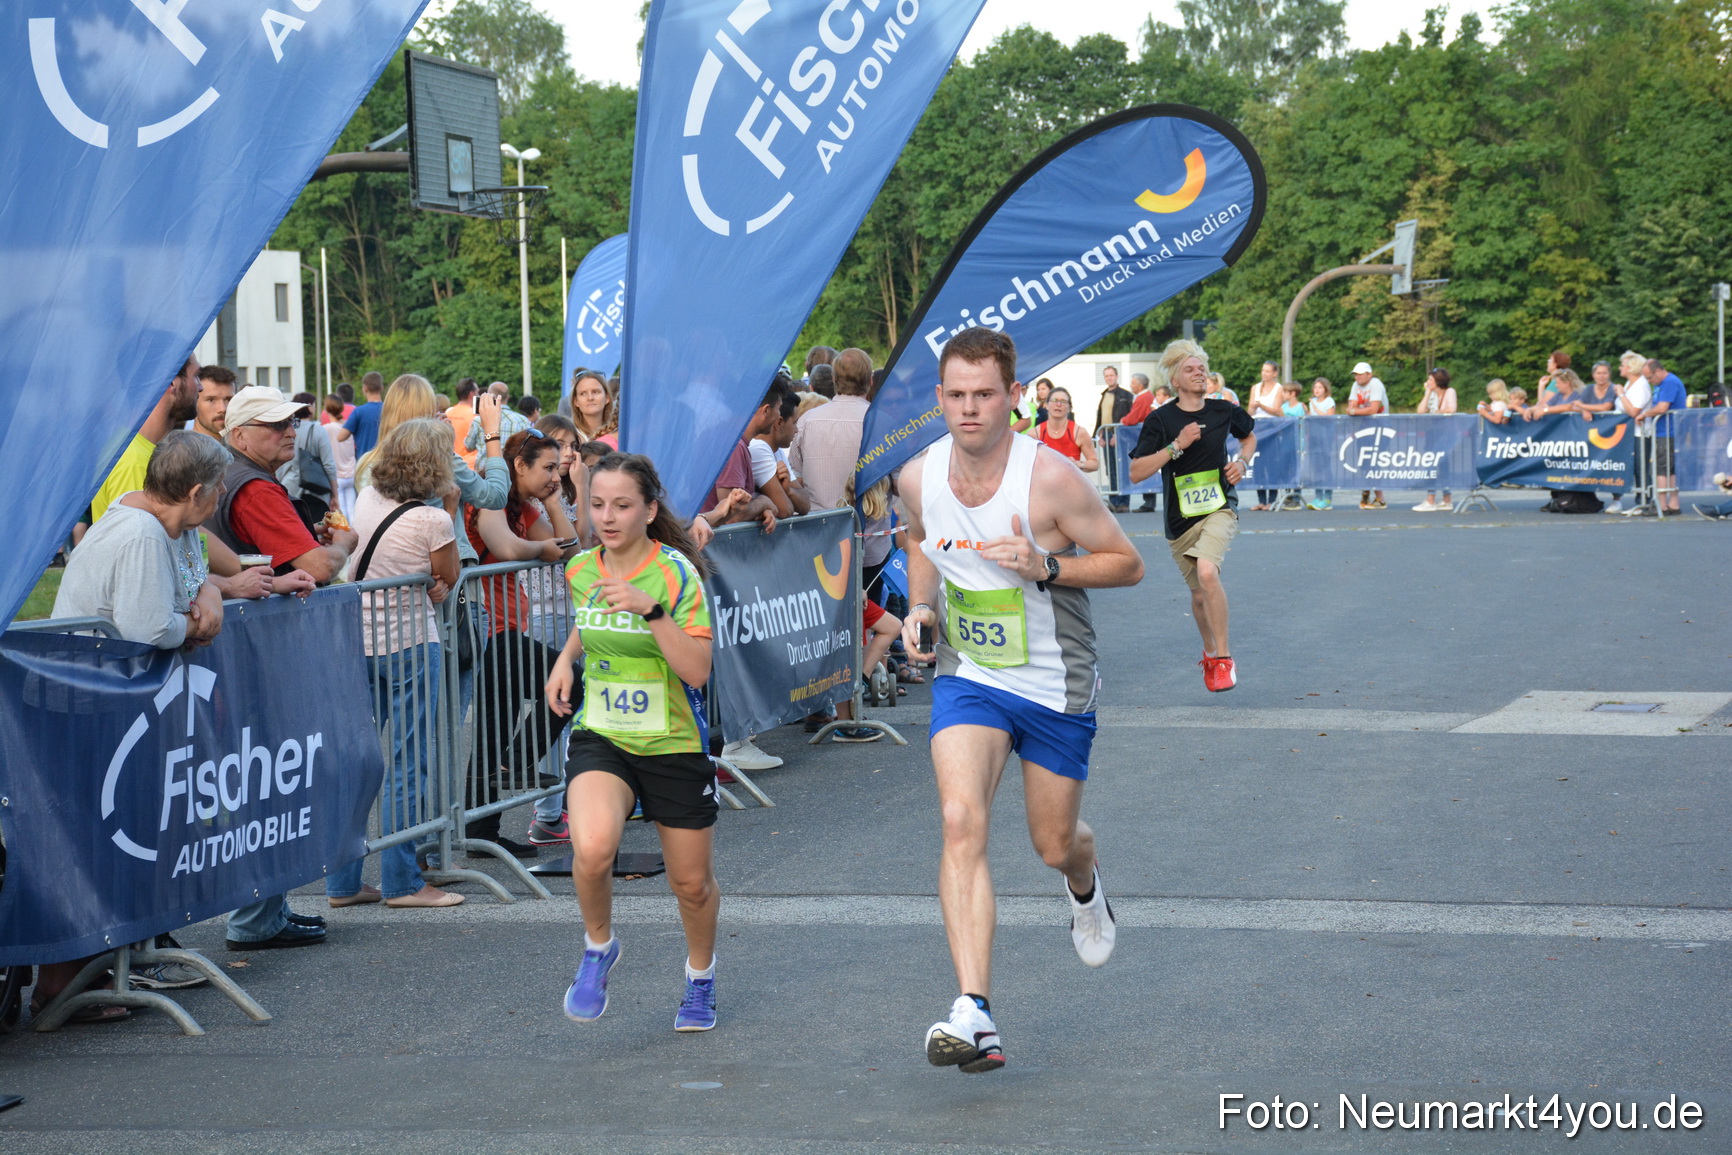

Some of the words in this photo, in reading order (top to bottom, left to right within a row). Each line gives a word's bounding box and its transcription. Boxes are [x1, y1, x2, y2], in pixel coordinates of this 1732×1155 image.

[735, 0, 880, 180] Fisc
[1078, 264, 1134, 303] Druck
[1136, 244, 1174, 270] und
[1173, 203, 1242, 252] Medien
[1357, 446, 1445, 467] Fischer
[1485, 436, 1589, 459] Frischmann
[1365, 470, 1437, 480] AUTOMOBILE
[1544, 458, 1571, 469] Druck
[1571, 460, 1589, 470] und
[1183, 486, 1218, 505] 1224
[713, 586, 826, 649] Frischmann
[958, 616, 1007, 647] 553
[786, 637, 811, 666] Druck
[814, 632, 829, 658] und
[600, 687, 649, 714] 149
[160, 726, 322, 831] Fischer
[171, 806, 311, 879] AUTOMOBILE
